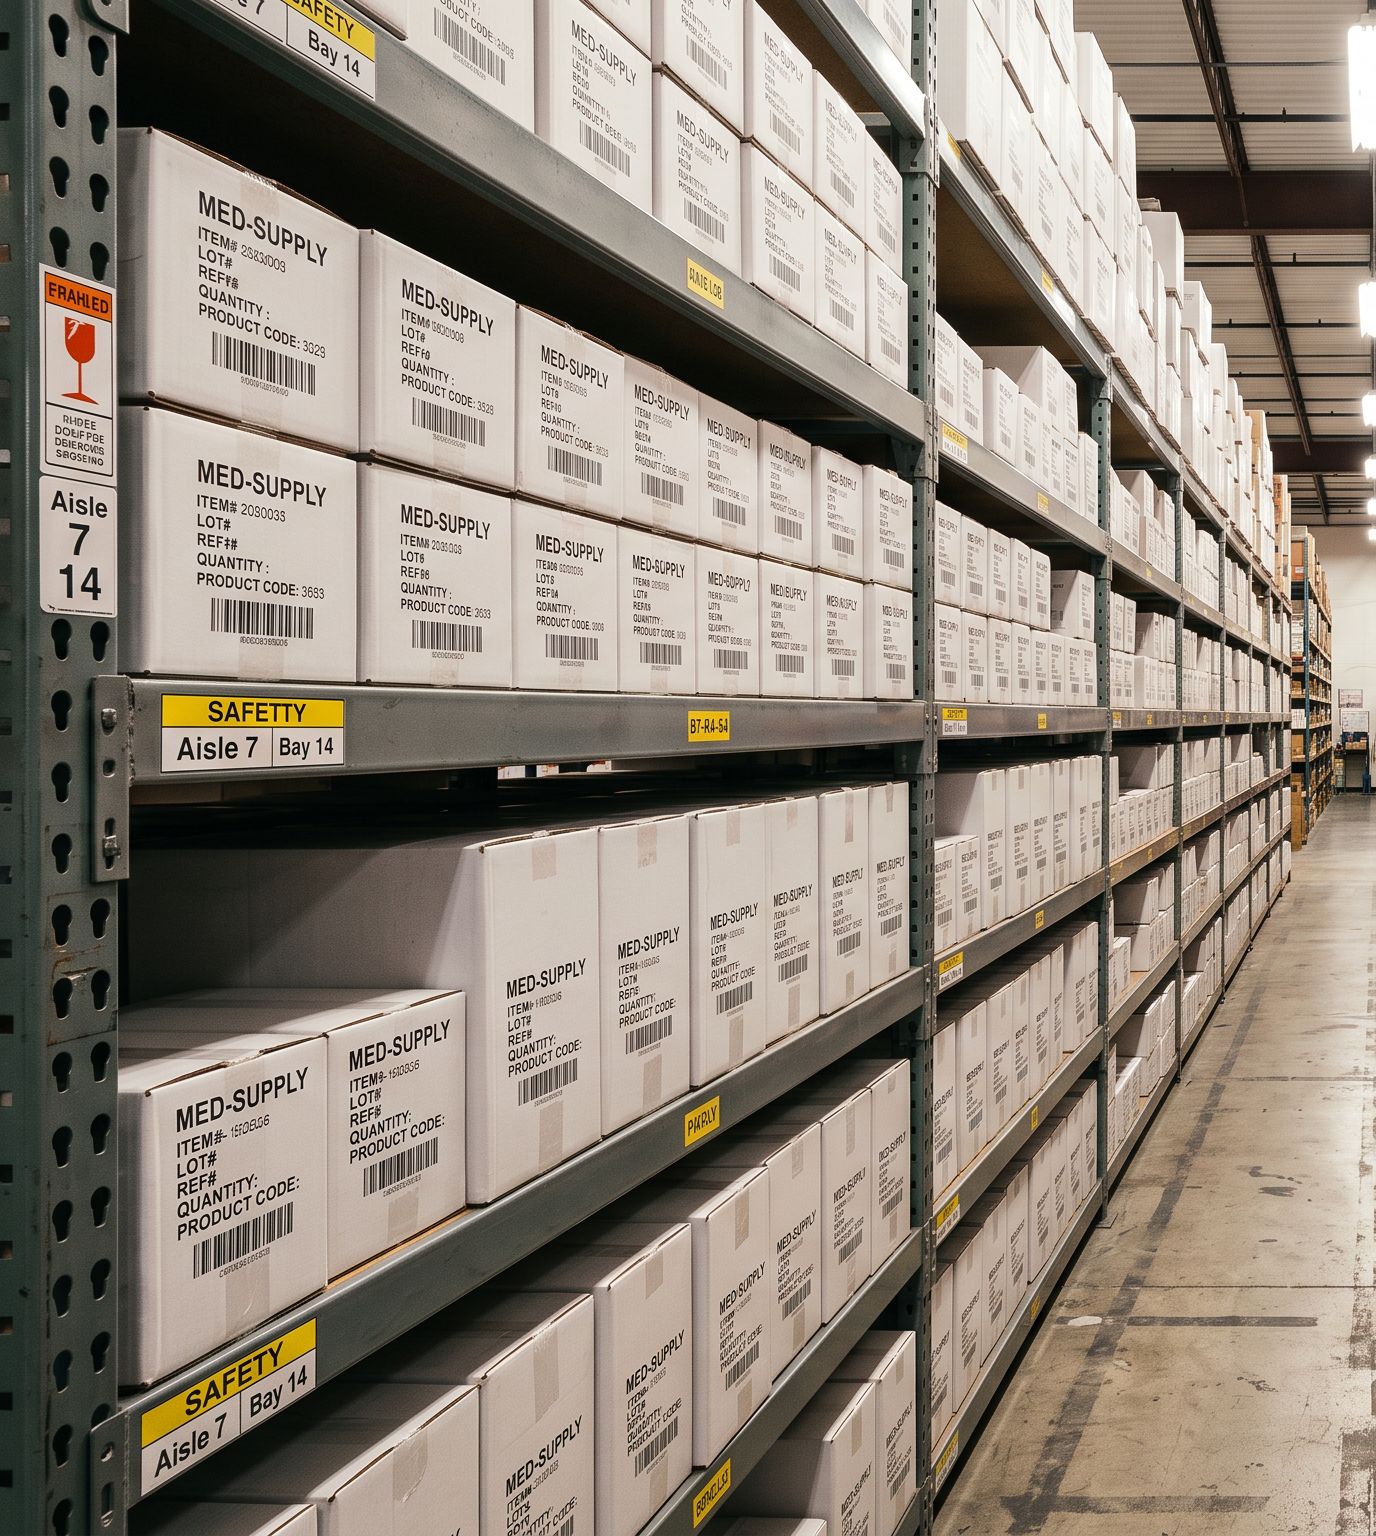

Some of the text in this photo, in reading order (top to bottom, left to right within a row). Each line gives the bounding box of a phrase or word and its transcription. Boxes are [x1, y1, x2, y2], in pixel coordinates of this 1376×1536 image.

[309, 29, 360, 77] Bay 14
[572, 19, 637, 87] MED-SUPPLY
[199, 190, 328, 267] MED-SUPPLY
[402, 278, 494, 336] MED-SUPPLY
[199, 303, 260, 336] PRODUCT
[264, 325, 300, 351] CODE:
[542, 344, 609, 390] MED-SUPPLY
[402, 374, 446, 400] PRODUCT
[634, 384, 690, 422] MED-SUPPLY
[198, 459, 327, 508] MED-SUPPLY
[51, 490, 108, 518] Aisle
[197, 514, 231, 532] LOT#
[401, 504, 490, 540] MED-SUPPLY
[68, 522, 90, 556] 7
[536, 534, 604, 563] MED-SUPPLY
[60, 564, 102, 600] 14
[197, 572, 299, 598] PRODUCT CODE:
[401, 582, 448, 598] QUANTITY
[401, 598, 446, 615] PRODUCT
[208, 700, 307, 723] SAFETTY
[177, 736, 334, 760] Aisle 7 Bay 14
[710, 902, 758, 930] MED-SUPPLY
[618, 926, 680, 960] MED-SUPPLY
[506, 958, 586, 1000] MED-SUPPLY
[349, 1019, 451, 1072] MED-SUPPLY
[508, 1034, 556, 1062] QUANTITY:
[508, 1039, 582, 1078] PRODUCT CODE:
[176, 1067, 308, 1133] MED-SUPPLY
[350, 1111, 412, 1146] QUANTITY:
[350, 1114, 446, 1164] PRODUCT CODE:
[176, 1151, 218, 1179] LOT#
[176, 1170, 217, 1199] REF#
[176, 1174, 258, 1218] QUANTITY:
[177, 1176, 300, 1242] PRODUCT CODE:
[185, 1341, 284, 1416] SAFETY
[626, 1329, 685, 1395] MED-SUPPLY
[154, 1365, 308, 1478] Aisle 7 Bay 14
[506, 1415, 582, 1498] MED-SUPPLY
